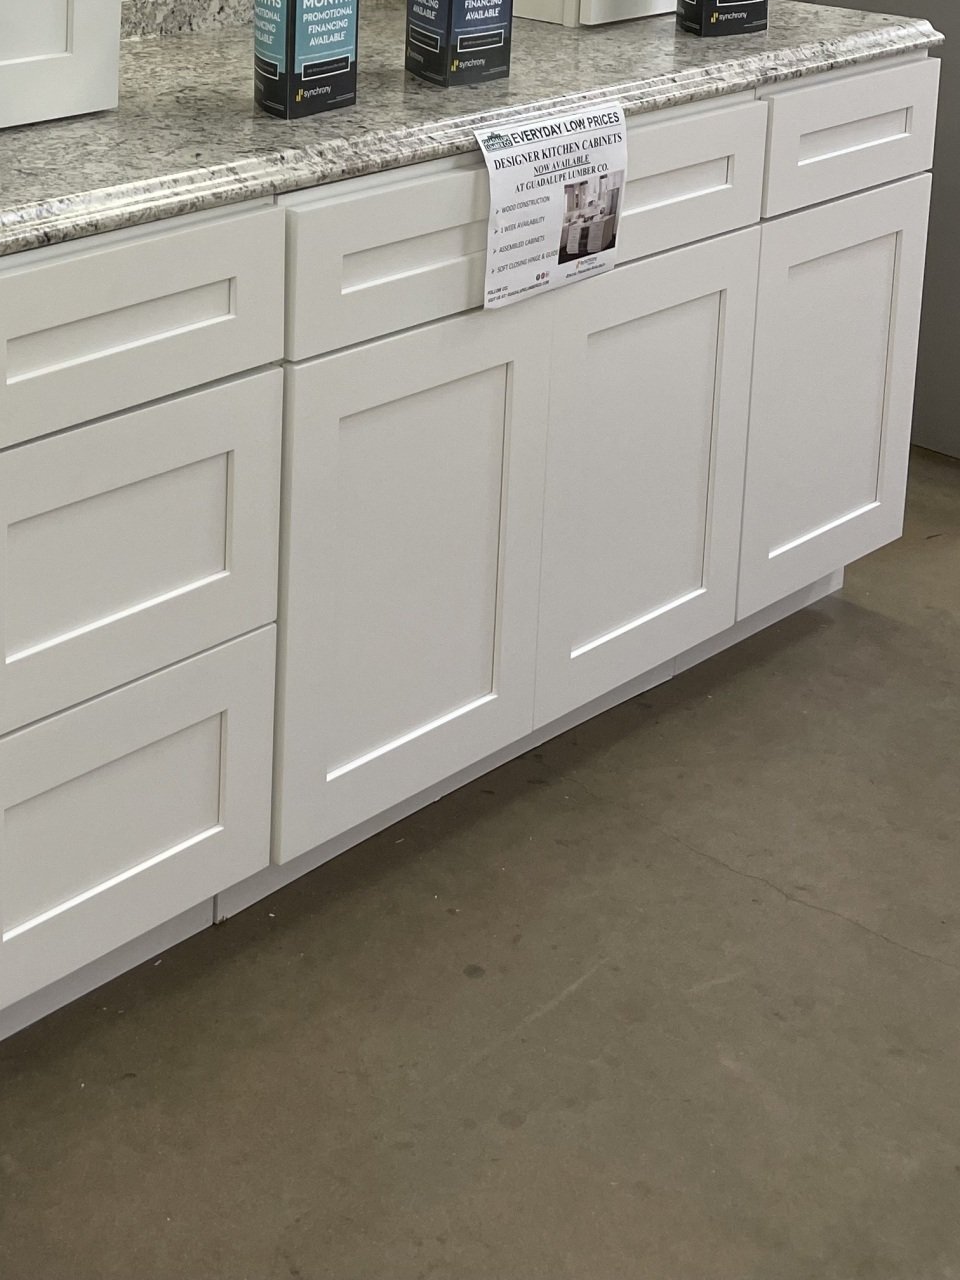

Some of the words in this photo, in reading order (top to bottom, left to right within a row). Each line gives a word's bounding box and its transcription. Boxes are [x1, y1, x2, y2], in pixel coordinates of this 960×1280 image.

[303, 8, 352, 23] PROMOTIONAL
[719, 10, 747, 22] synchrony
[308, 19, 348, 34] FINANCING
[459, 58, 486, 70] synchrony
[304, 85, 331, 99] synchrony
[510, 124, 565, 144] EVERYDAY
[564, 118, 586, 132] LOW
[587, 112, 620, 129] PRICES
[494, 152, 540, 170] DESIGNER
[542, 142, 580, 160] KITCHEN
[582, 132, 623, 150] CABINETS
[533, 164, 550, 175] NOW
[551, 154, 590, 170] AVAILABLE
[515, 184, 525, 193] AT
[526, 173, 567, 190] GUADALUPE
[568, 168, 596, 180] LUMBER
[597, 163, 609, 173] CO.
[502, 203, 516, 214] WOOD
[517, 196, 550, 211] CONSTRUCTION
[525, 234, 545, 246] CABINETS
